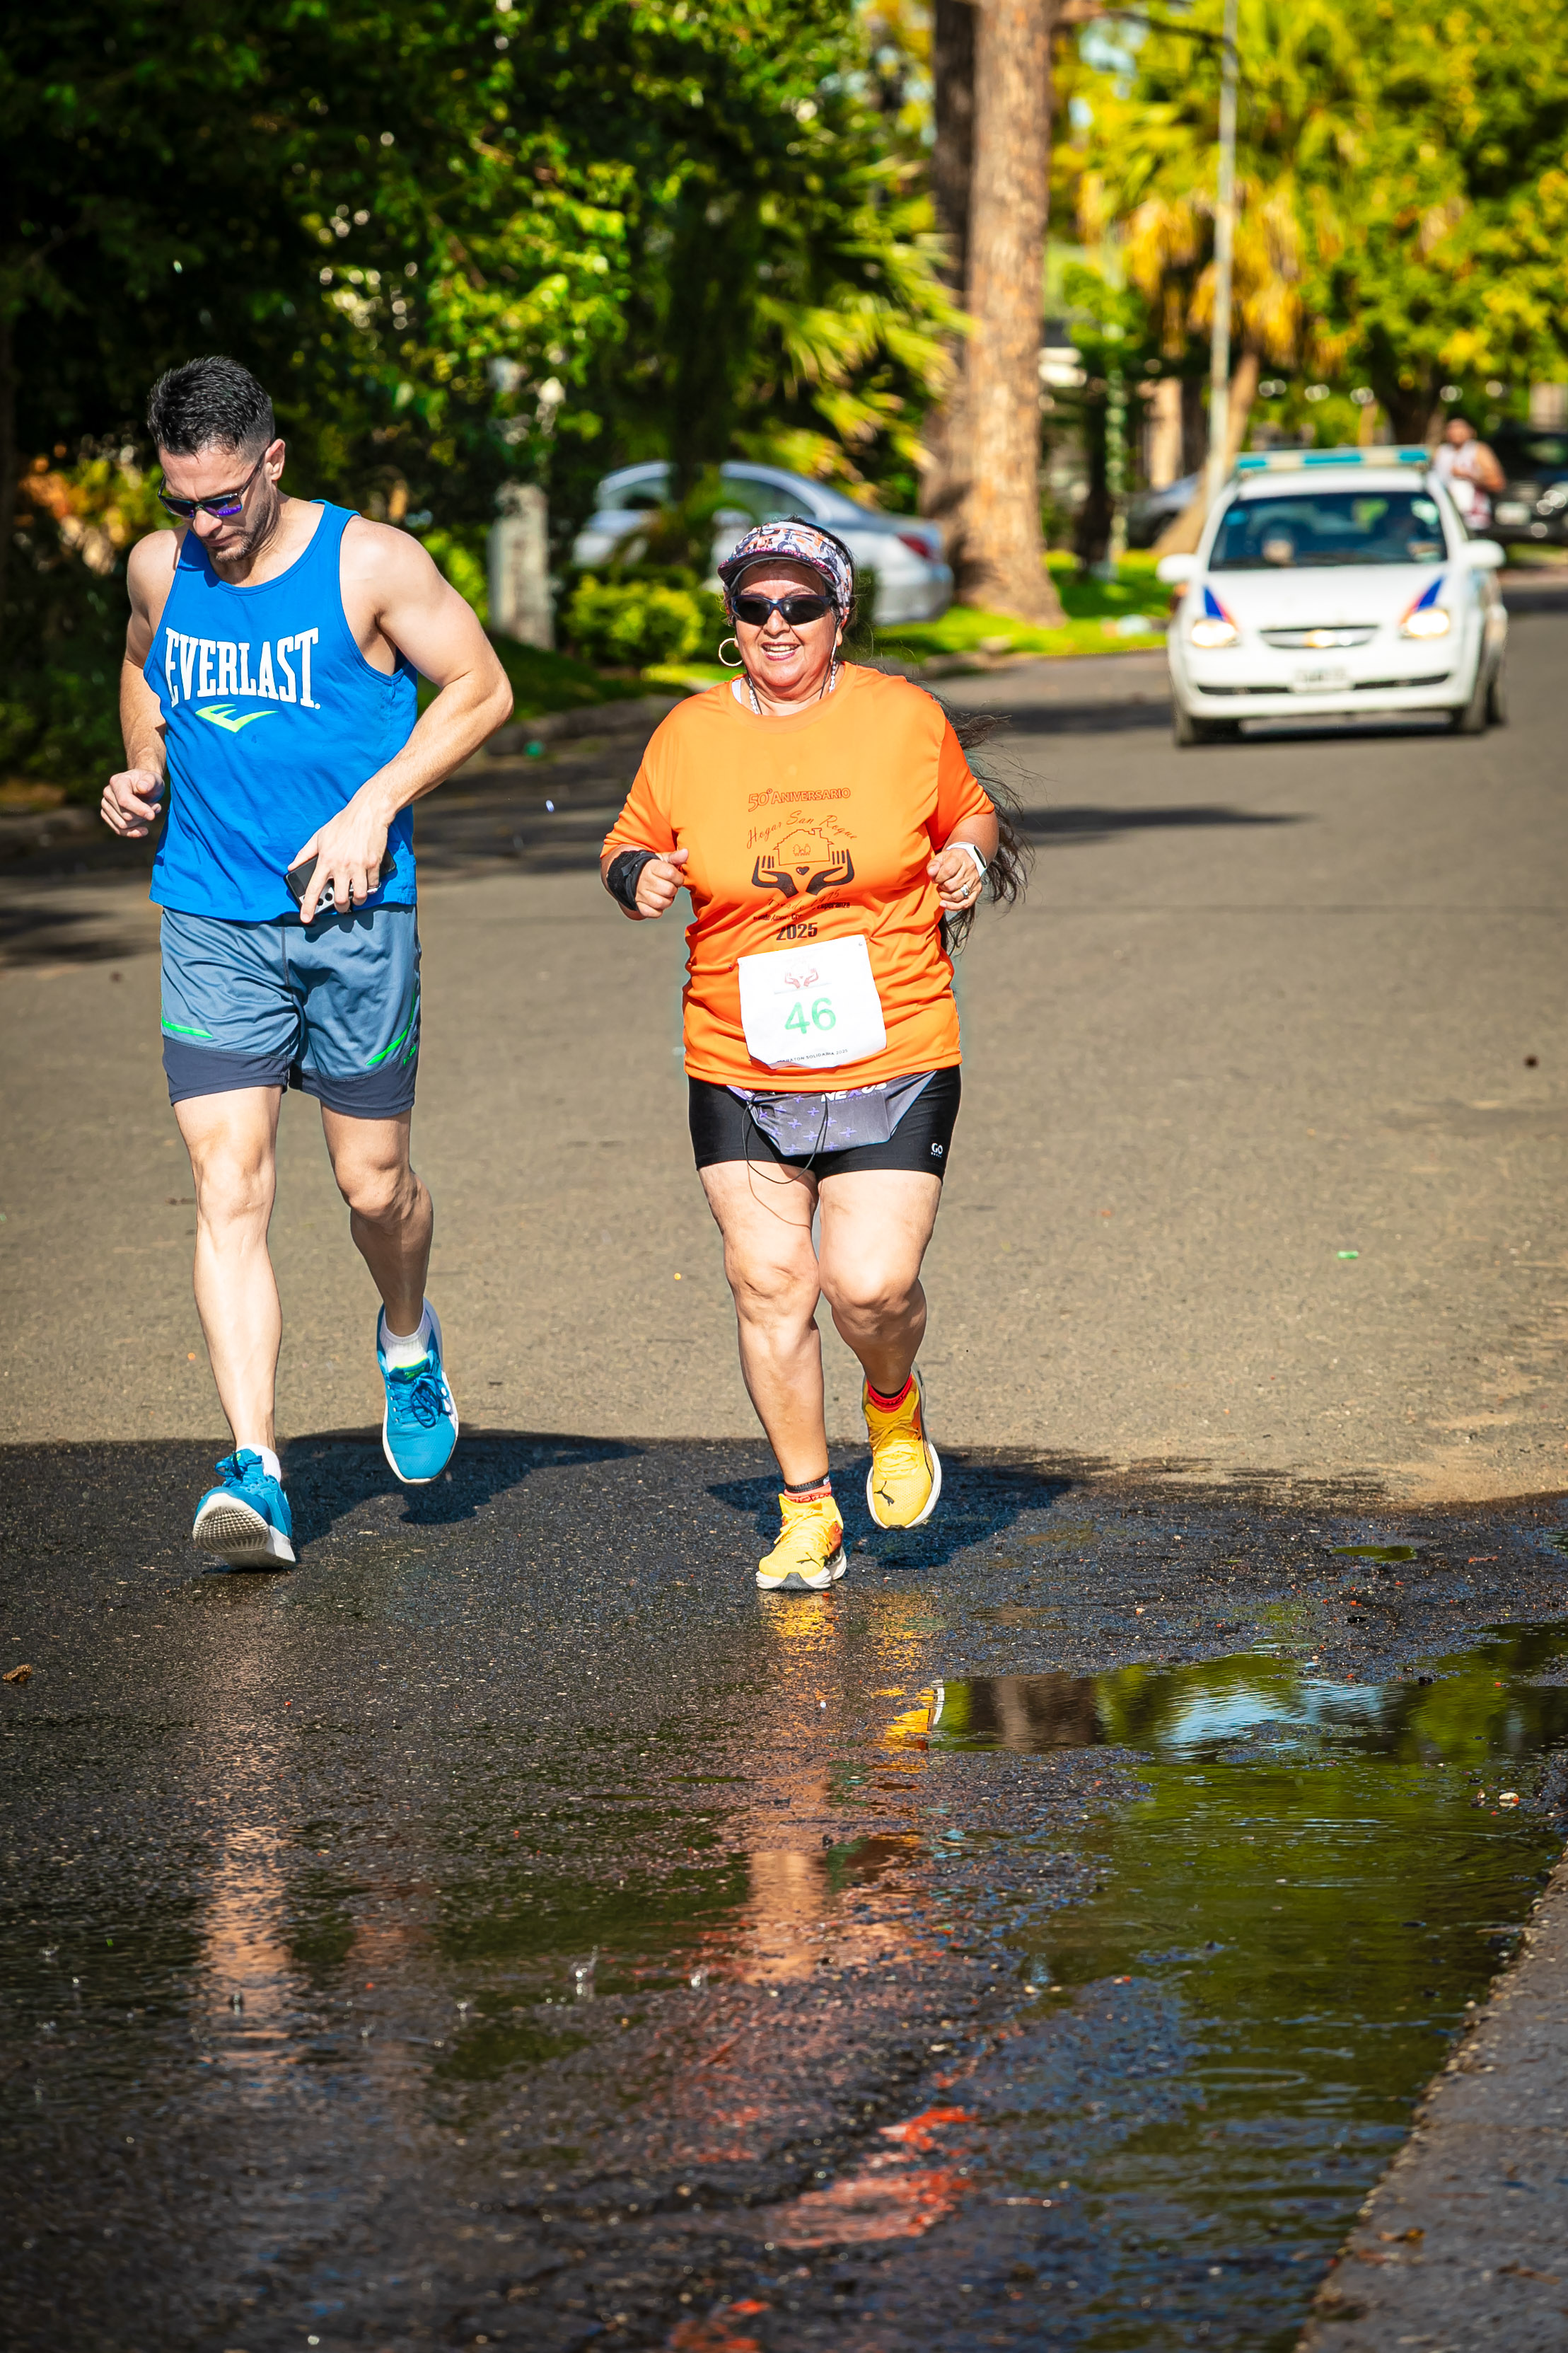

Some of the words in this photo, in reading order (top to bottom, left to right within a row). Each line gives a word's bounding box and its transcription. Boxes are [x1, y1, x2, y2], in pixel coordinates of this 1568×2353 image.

[165, 627, 318, 707] EVERLAST
[771, 787, 851, 804] ANIVERSARIO
[747, 821, 782, 849] Hogar
[786, 810, 814, 826] San
[820, 815, 858, 840] Roque
[776, 922, 818, 940] 2025
[784, 997, 837, 1034] 46
[931, 1143, 943, 1155] GO
